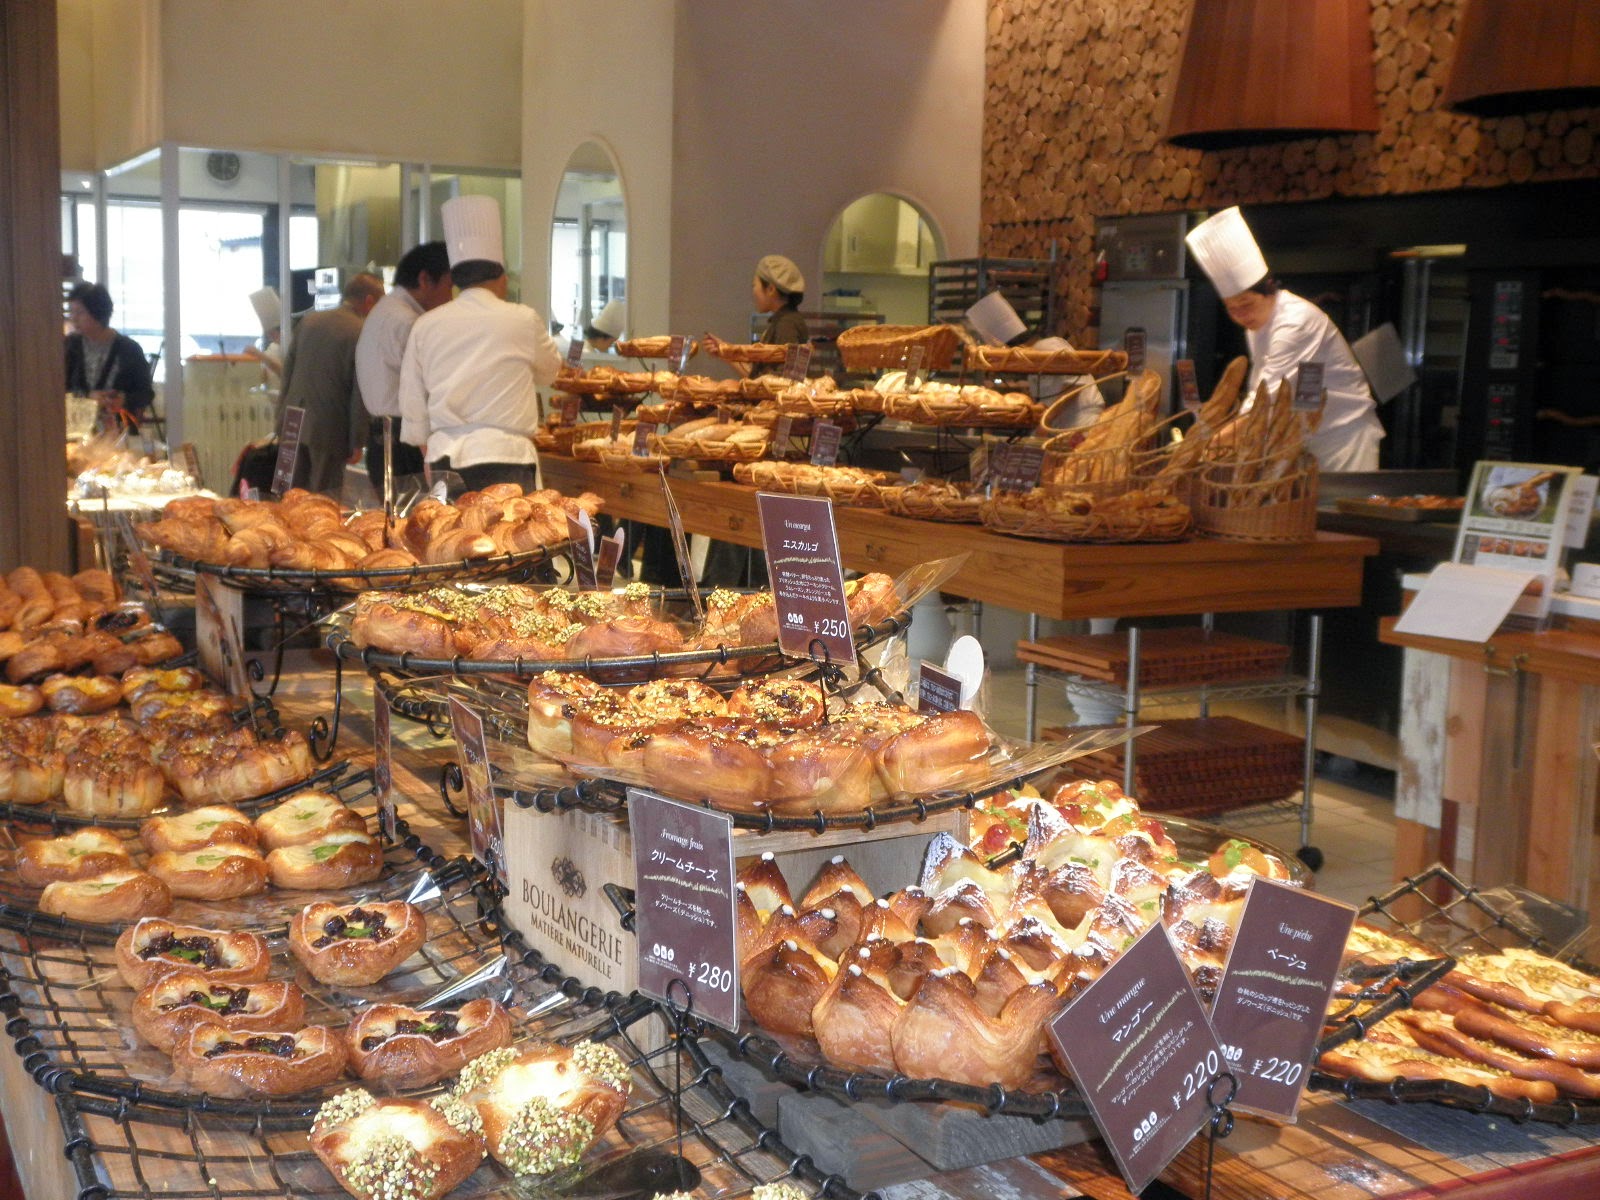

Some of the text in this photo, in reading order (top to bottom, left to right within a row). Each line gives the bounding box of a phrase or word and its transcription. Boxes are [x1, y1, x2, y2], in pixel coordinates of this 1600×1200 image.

[783, 540, 819, 552] エスカルゴ
[651, 849, 719, 881] クリームチーズ
[522, 878, 622, 966] BOULANGERIE
[530, 912, 564, 946] MATIÈRE
[565, 936, 612, 979] NATURELLE
[1098, 977, 1146, 1024] Une mangue
[1112, 1001, 1154, 1042] マンゴー
